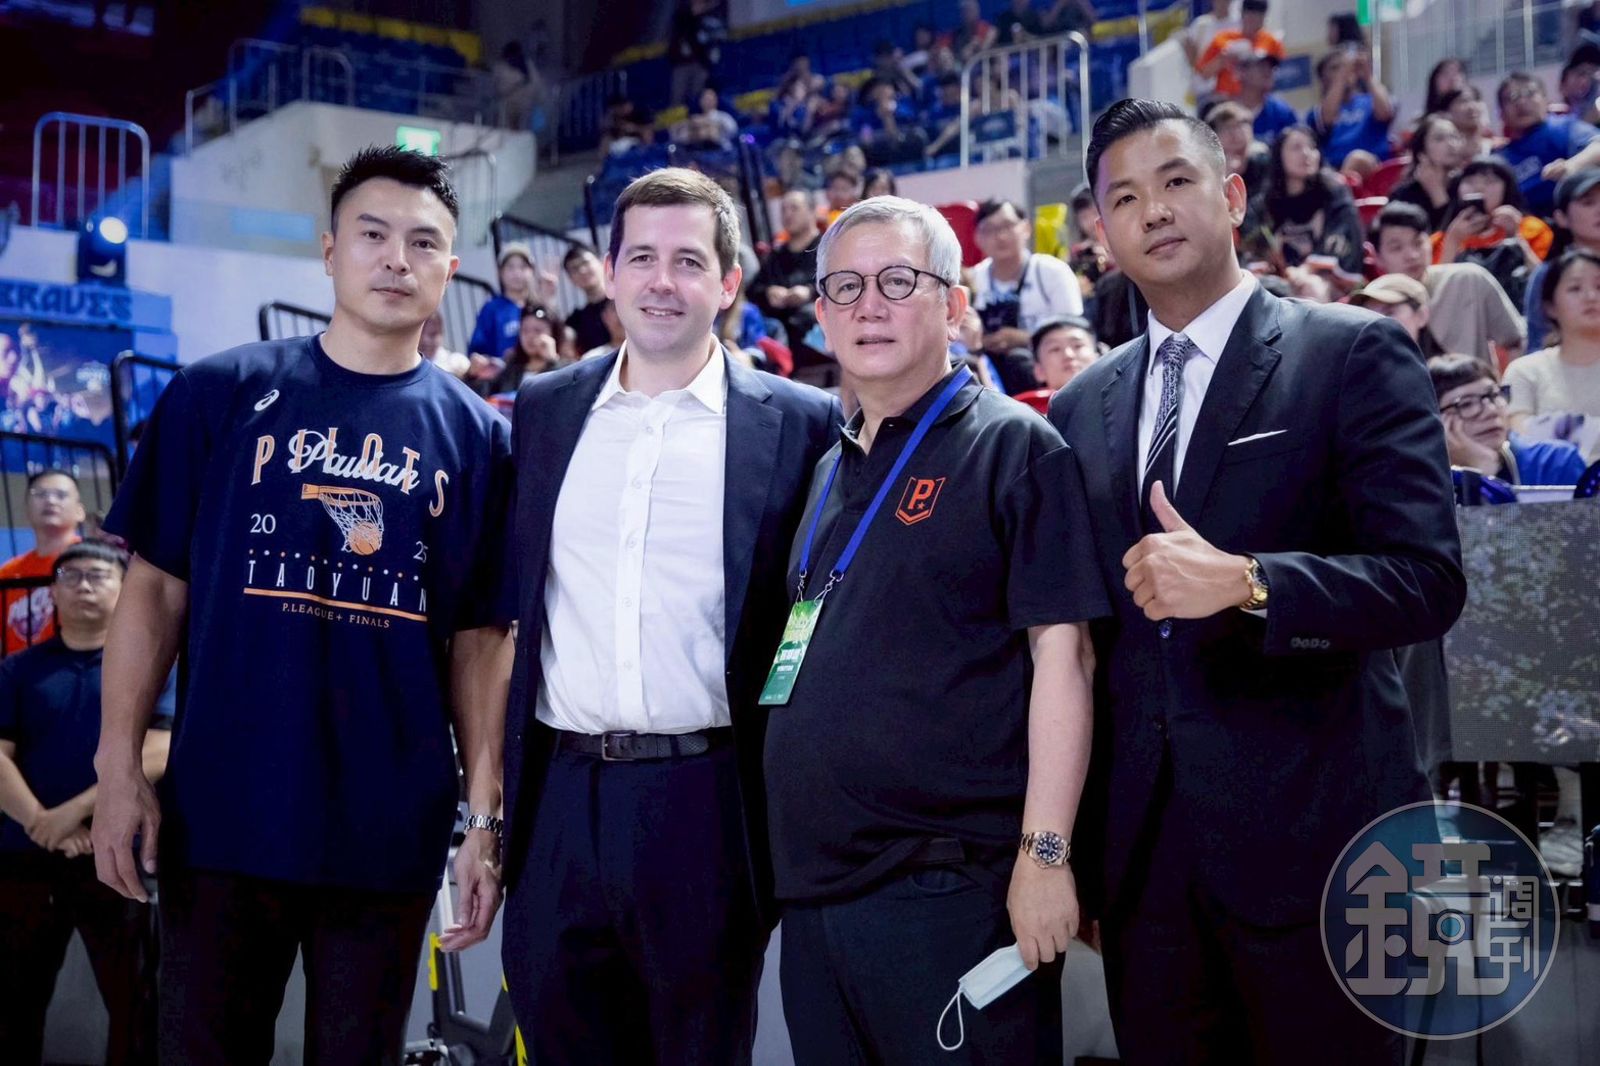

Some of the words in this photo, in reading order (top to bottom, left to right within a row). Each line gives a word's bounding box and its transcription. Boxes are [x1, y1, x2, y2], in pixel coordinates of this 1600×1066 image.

[251, 427, 449, 517] PILOTS
[250, 514, 276, 534] 20
[248, 559, 427, 612] TAOYUAN
[349, 614, 390, 628] FINALS
